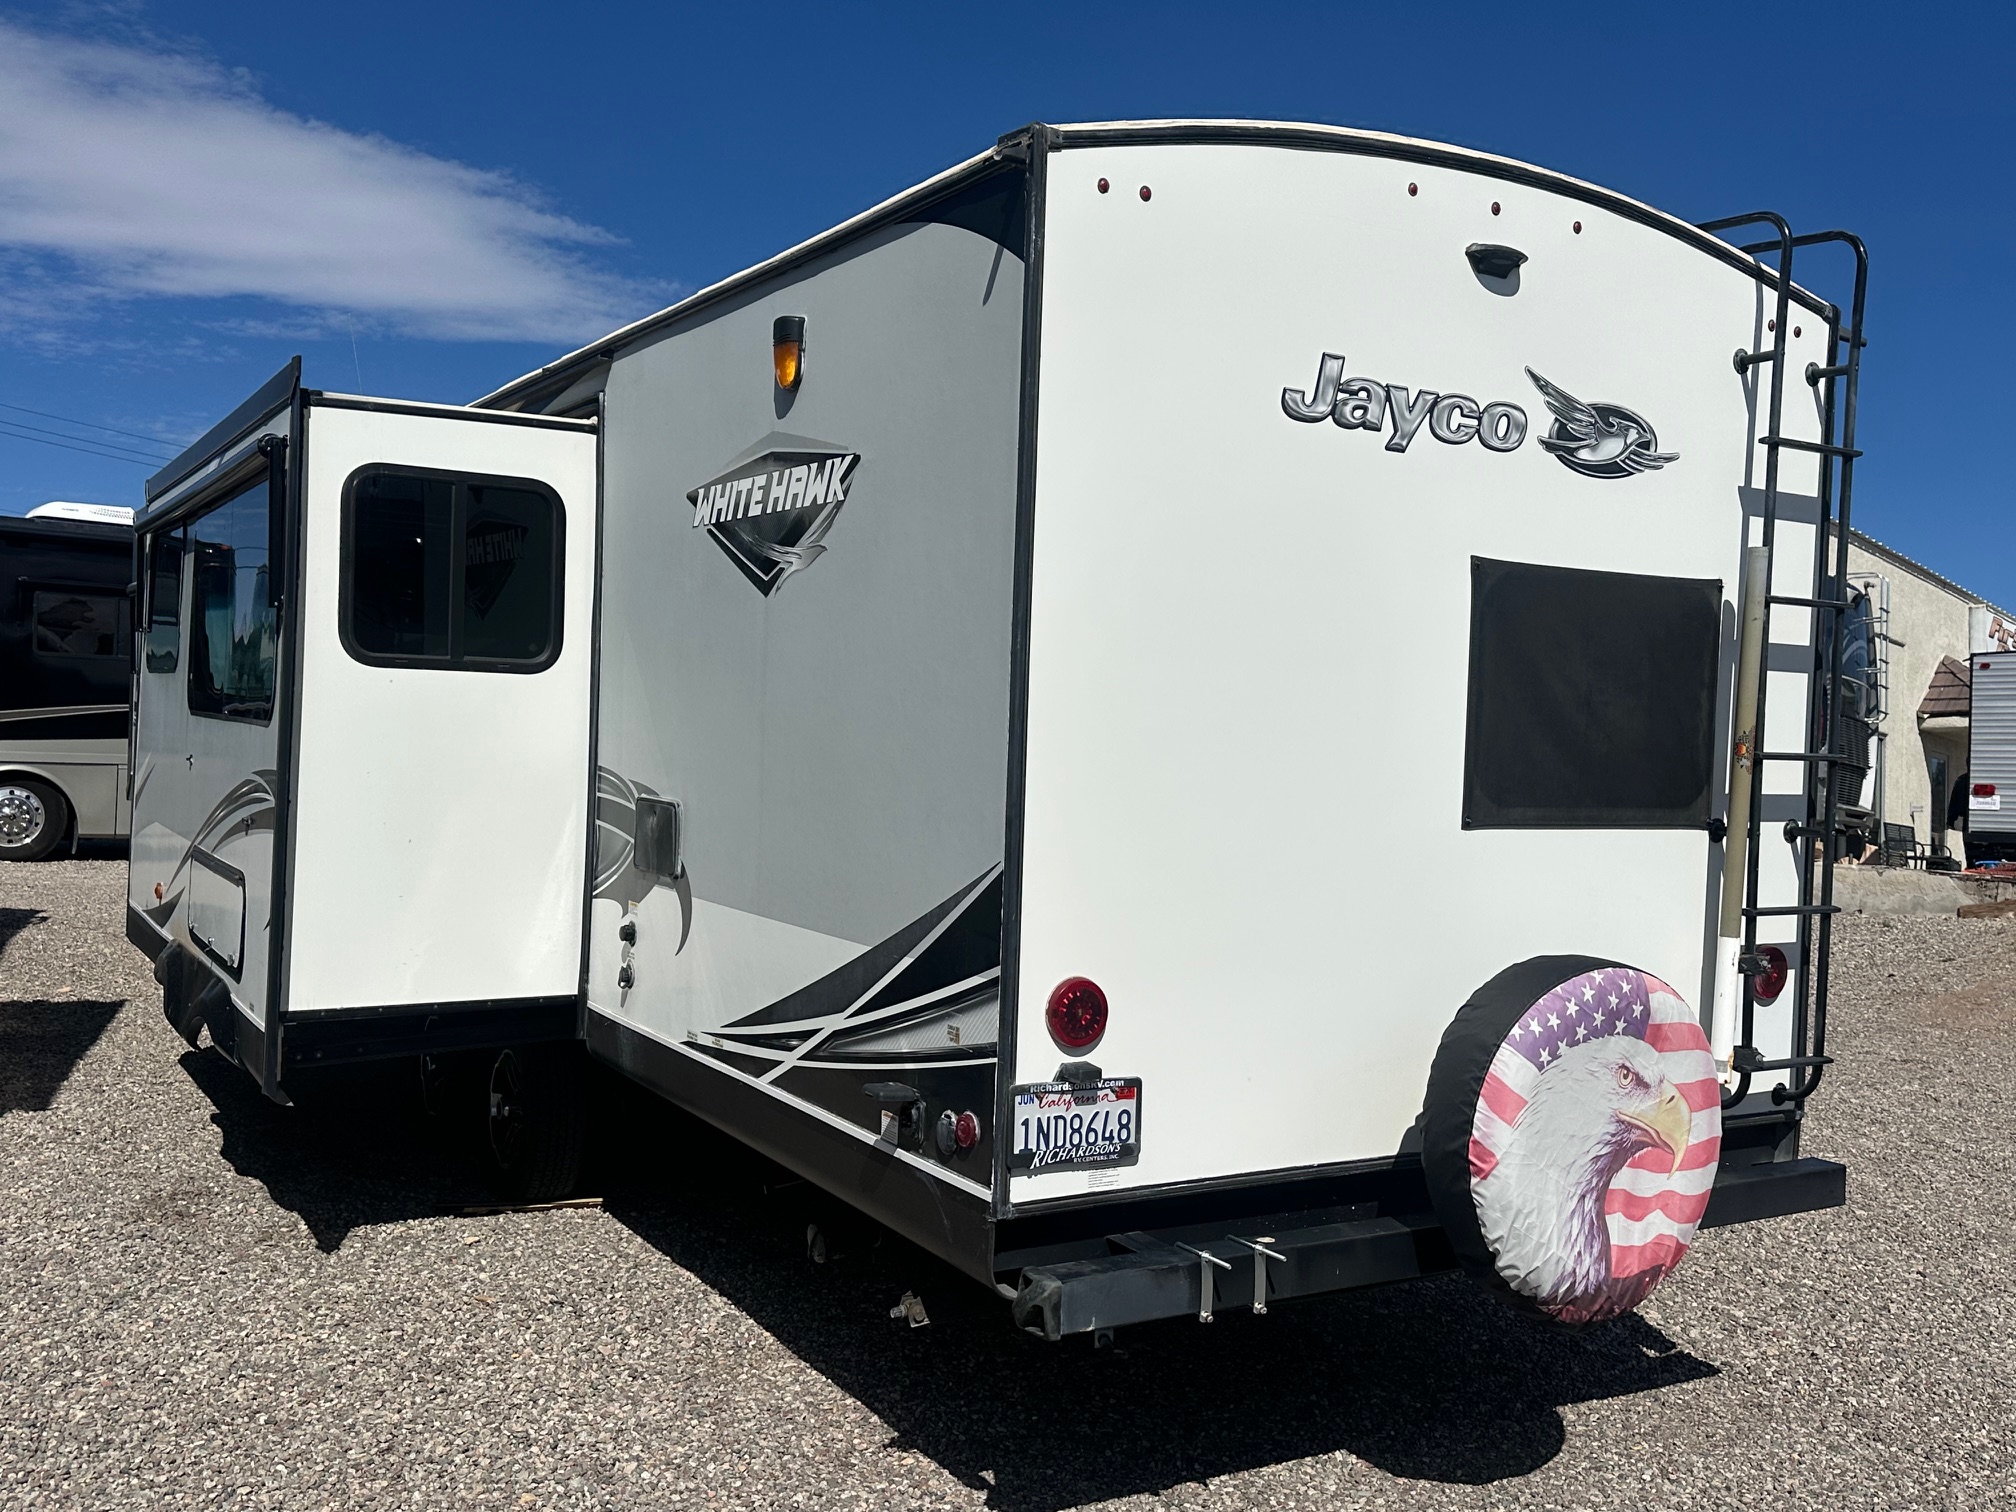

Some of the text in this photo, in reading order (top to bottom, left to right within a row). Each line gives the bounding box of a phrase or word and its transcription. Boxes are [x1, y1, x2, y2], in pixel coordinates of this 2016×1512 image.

[1281, 351, 1528, 454] Jayco
[692, 454, 854, 528] WHITE HAWK
[1018, 1094, 1035, 1106] JUN
[1038, 1091, 1118, 1112] California
[1020, 1109, 1132, 1152] 1ND8648
[1030, 1142, 1122, 1170] RICHARDSON'S
